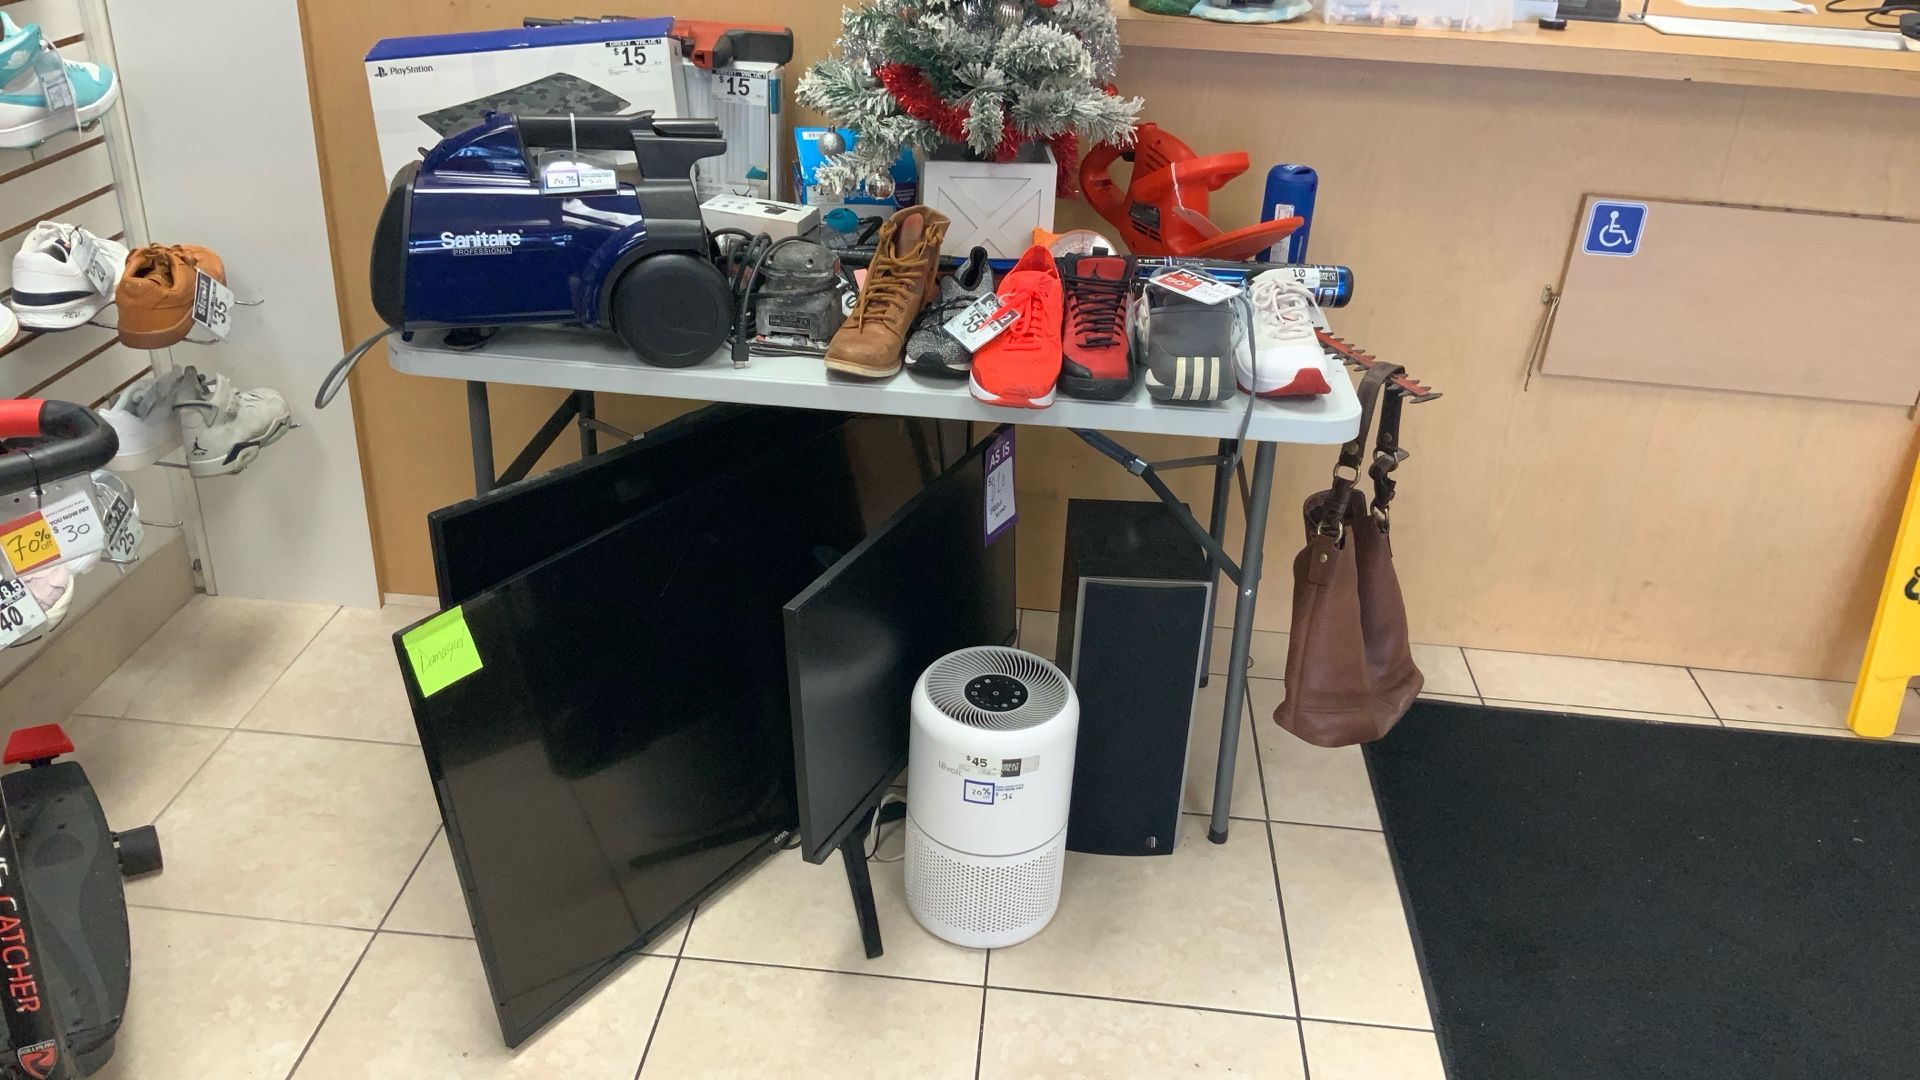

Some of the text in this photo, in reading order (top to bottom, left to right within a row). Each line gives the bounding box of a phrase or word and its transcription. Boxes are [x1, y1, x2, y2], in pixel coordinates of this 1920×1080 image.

[389, 65, 434, 76] PlayStation
[440, 229, 521, 248] Sanitaire
[453, 247, 512, 256] PROFESSIONAL
[989, 449, 1001, 469] AS
[1002, 441, 1010, 458] IS
[49, 517, 62, 526] YOU
[62, 511, 78, 521] NOW
[966, 755, 988, 768] $45
